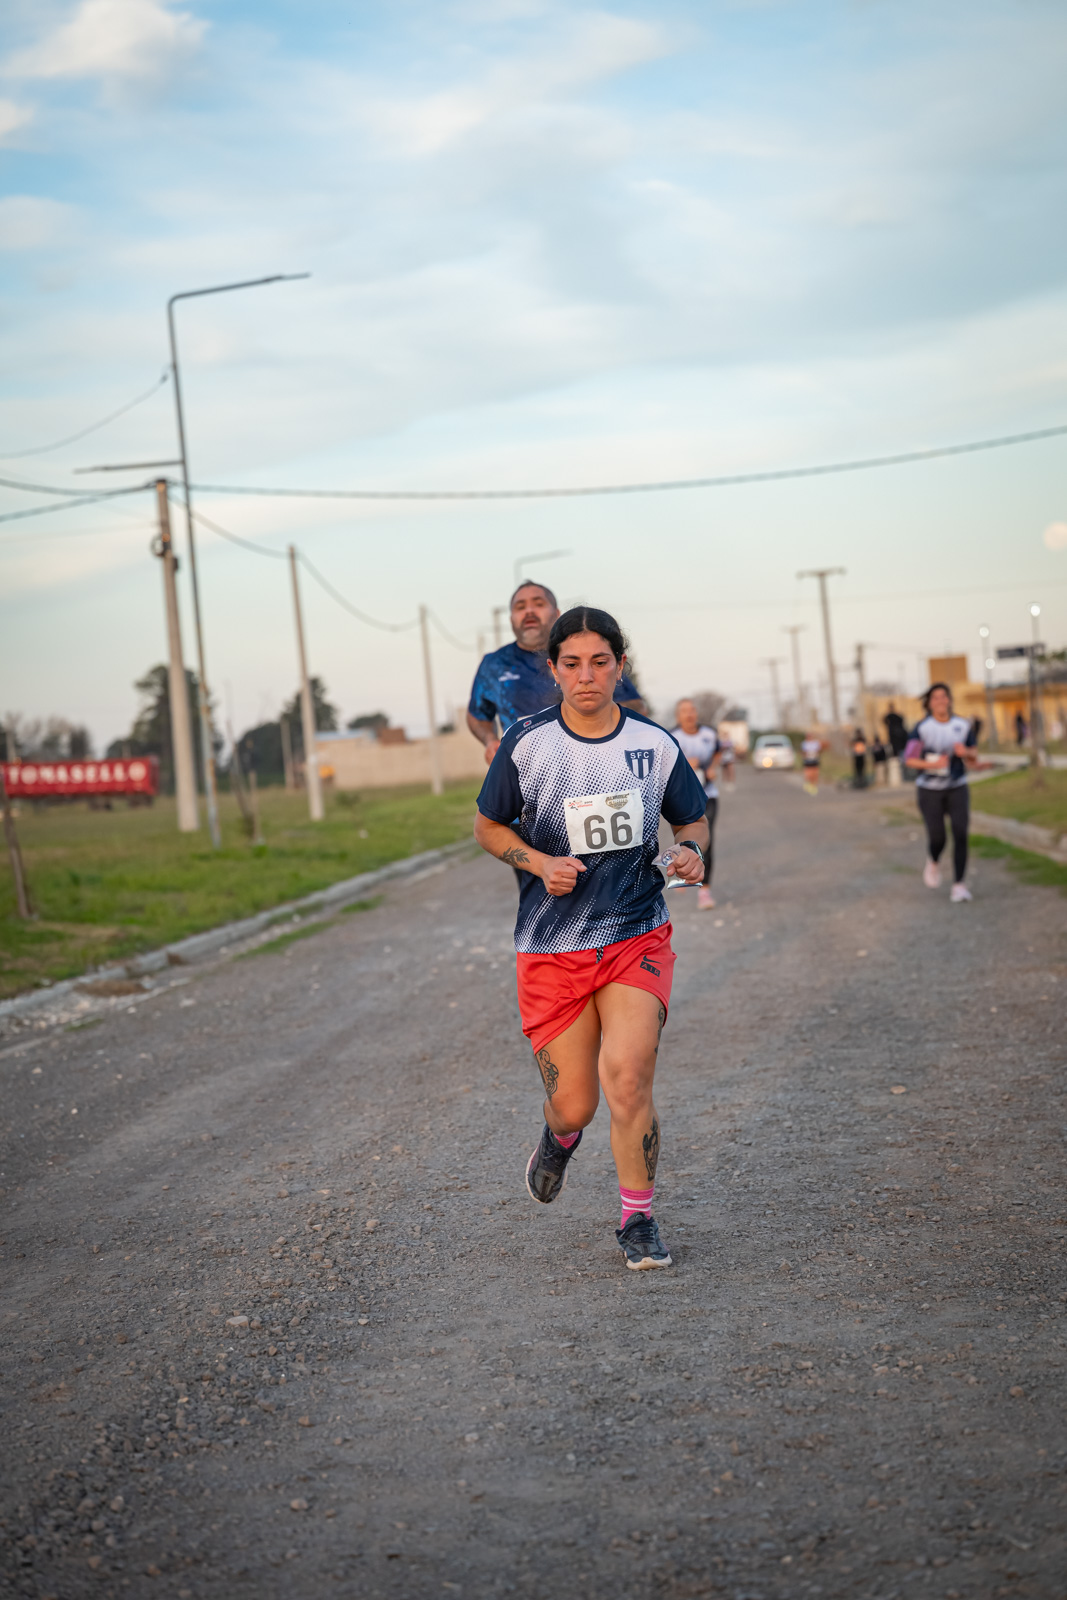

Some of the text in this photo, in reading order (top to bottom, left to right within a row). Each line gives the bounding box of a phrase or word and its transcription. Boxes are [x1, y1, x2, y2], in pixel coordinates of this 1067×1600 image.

[630, 751, 650, 759] SFC
[584, 811, 632, 850] 66
[641, 963, 660, 976] AIR
